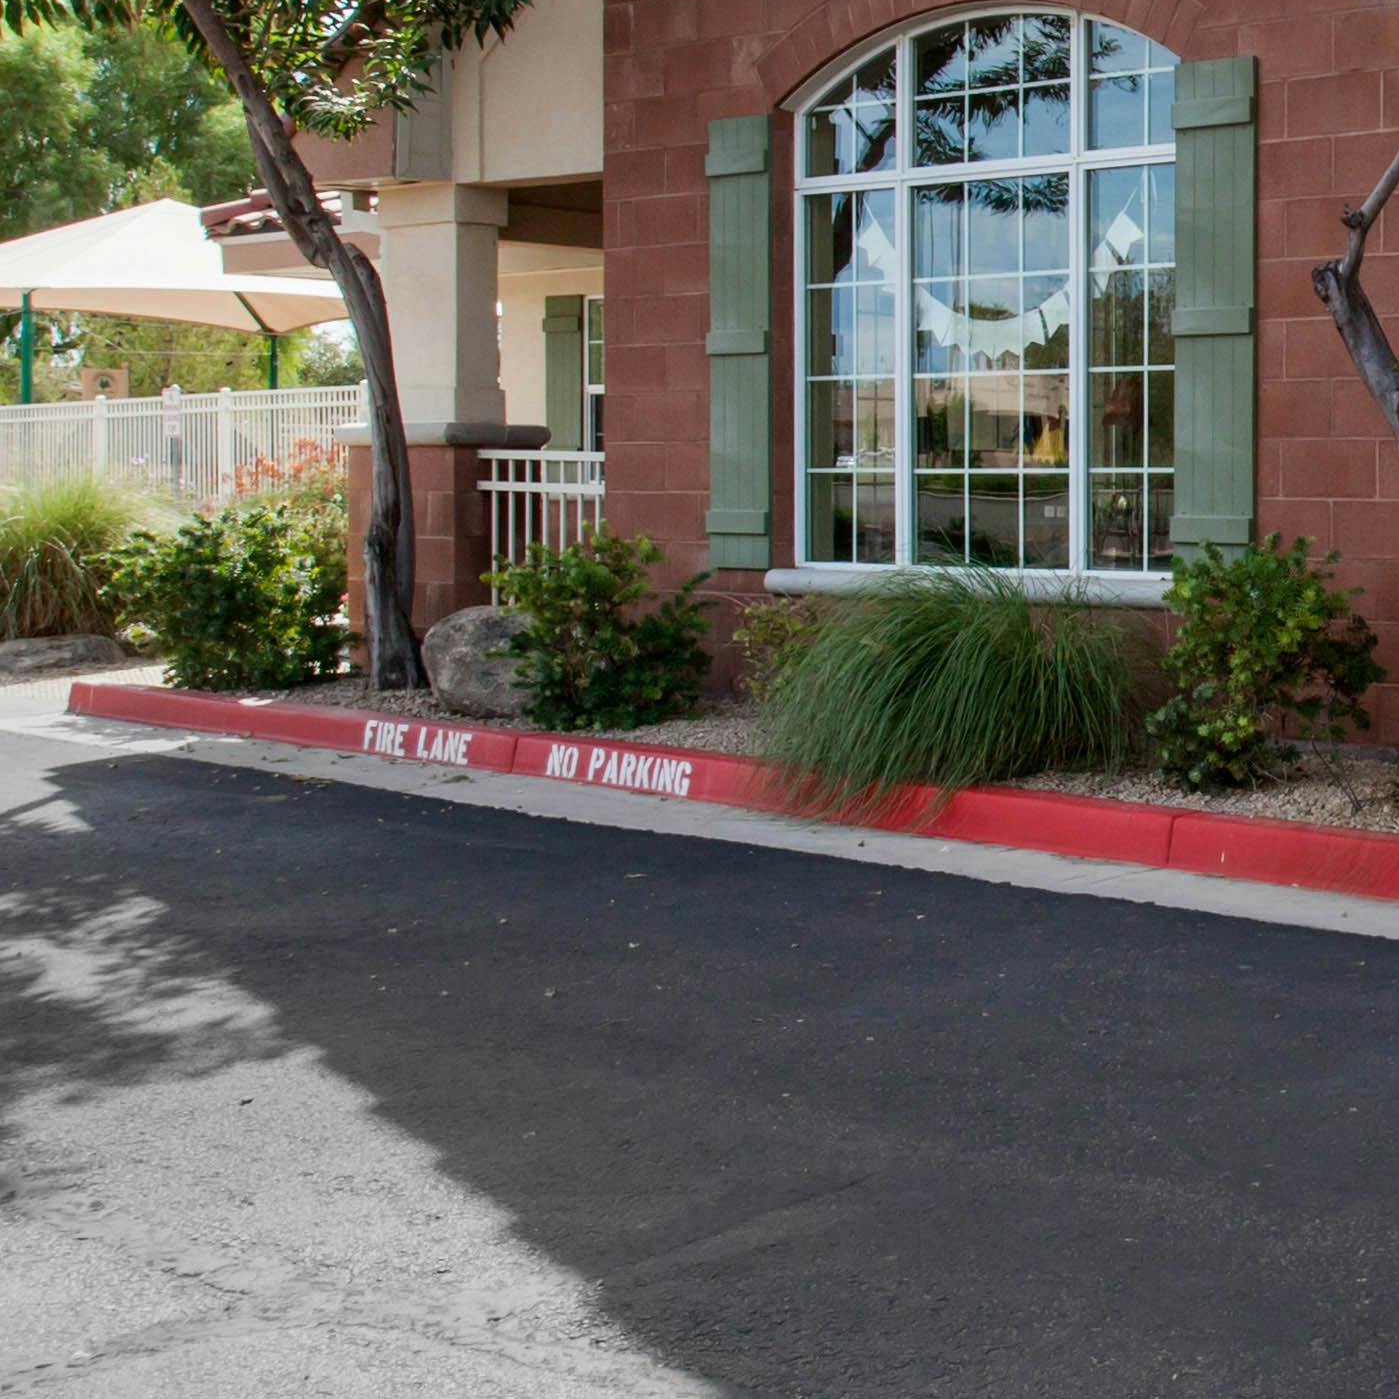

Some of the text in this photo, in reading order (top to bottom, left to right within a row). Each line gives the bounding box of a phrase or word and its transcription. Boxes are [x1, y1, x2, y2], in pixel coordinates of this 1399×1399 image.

[363, 719, 473, 766] FIRE LANE
[545, 743, 693, 797] NO PARKING
